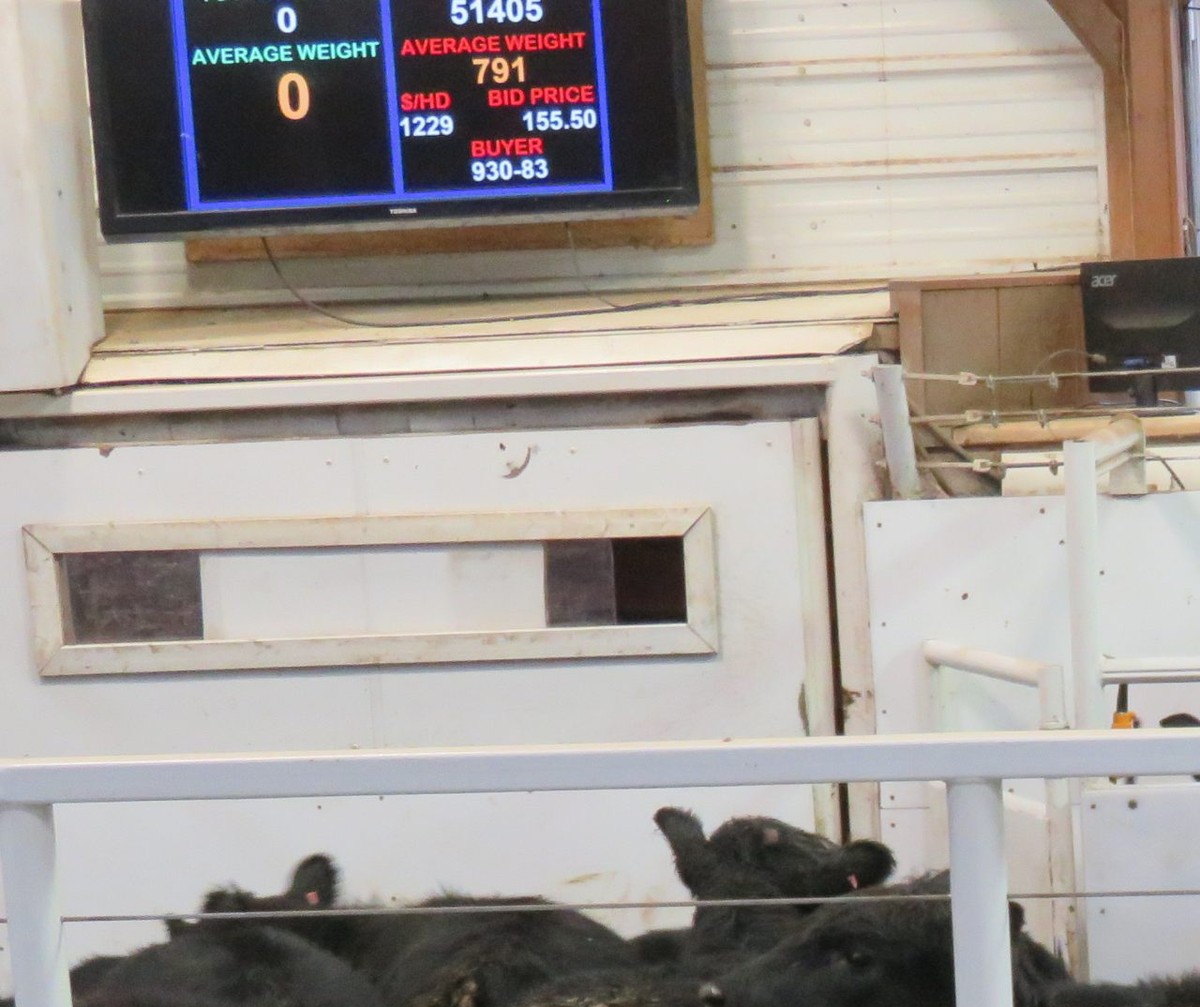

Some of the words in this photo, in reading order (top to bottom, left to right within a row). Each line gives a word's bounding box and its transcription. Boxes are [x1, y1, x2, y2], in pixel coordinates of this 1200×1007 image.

[277, 6, 297, 33] 0
[451, 0, 543, 25] 51405
[192, 45, 293, 65] AVERAGE
[297, 41, 380, 60] WEIGHT
[401, 36, 500, 56] AVERAGE
[505, 32, 586, 51] WEIGHT
[472, 56, 526, 84] 791
[277, 72, 310, 120] 0
[488, 88, 525, 107] BID
[530, 85, 595, 105] PRICE
[399, 115, 454, 137] 1229
[522, 109, 597, 131] 155.50
[471, 138, 544, 158] BUYER
[471, 159, 549, 182] 930-83
[1091, 274, 1118, 288] acer
